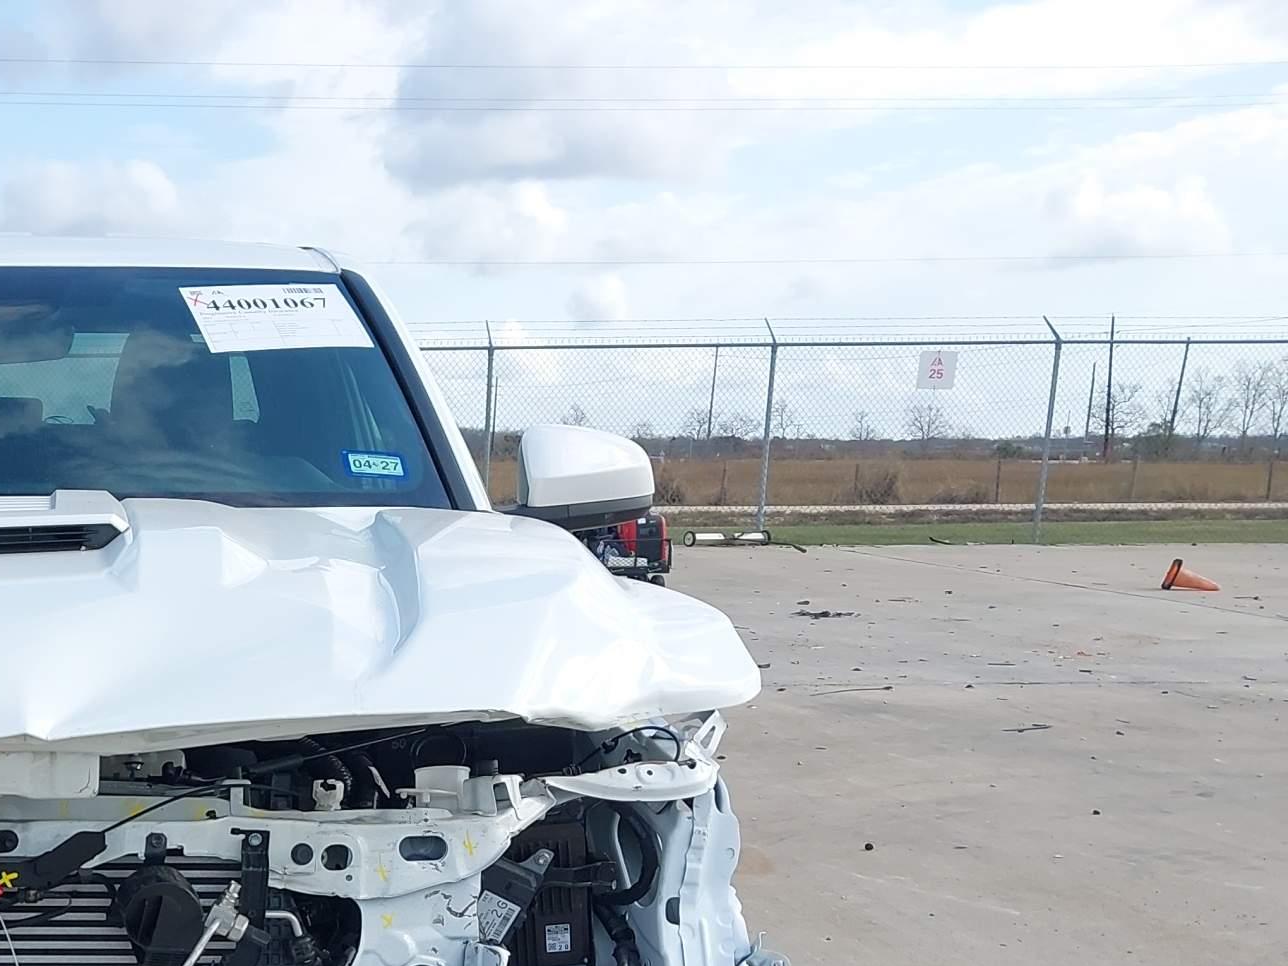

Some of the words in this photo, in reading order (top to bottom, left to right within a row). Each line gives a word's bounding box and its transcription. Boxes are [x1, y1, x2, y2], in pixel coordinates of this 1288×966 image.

[206, 297, 326, 311] 44001067
[928, 368, 945, 379] 25
[352, 459, 372, 470] 04
[380, 460, 399, 471] 27
